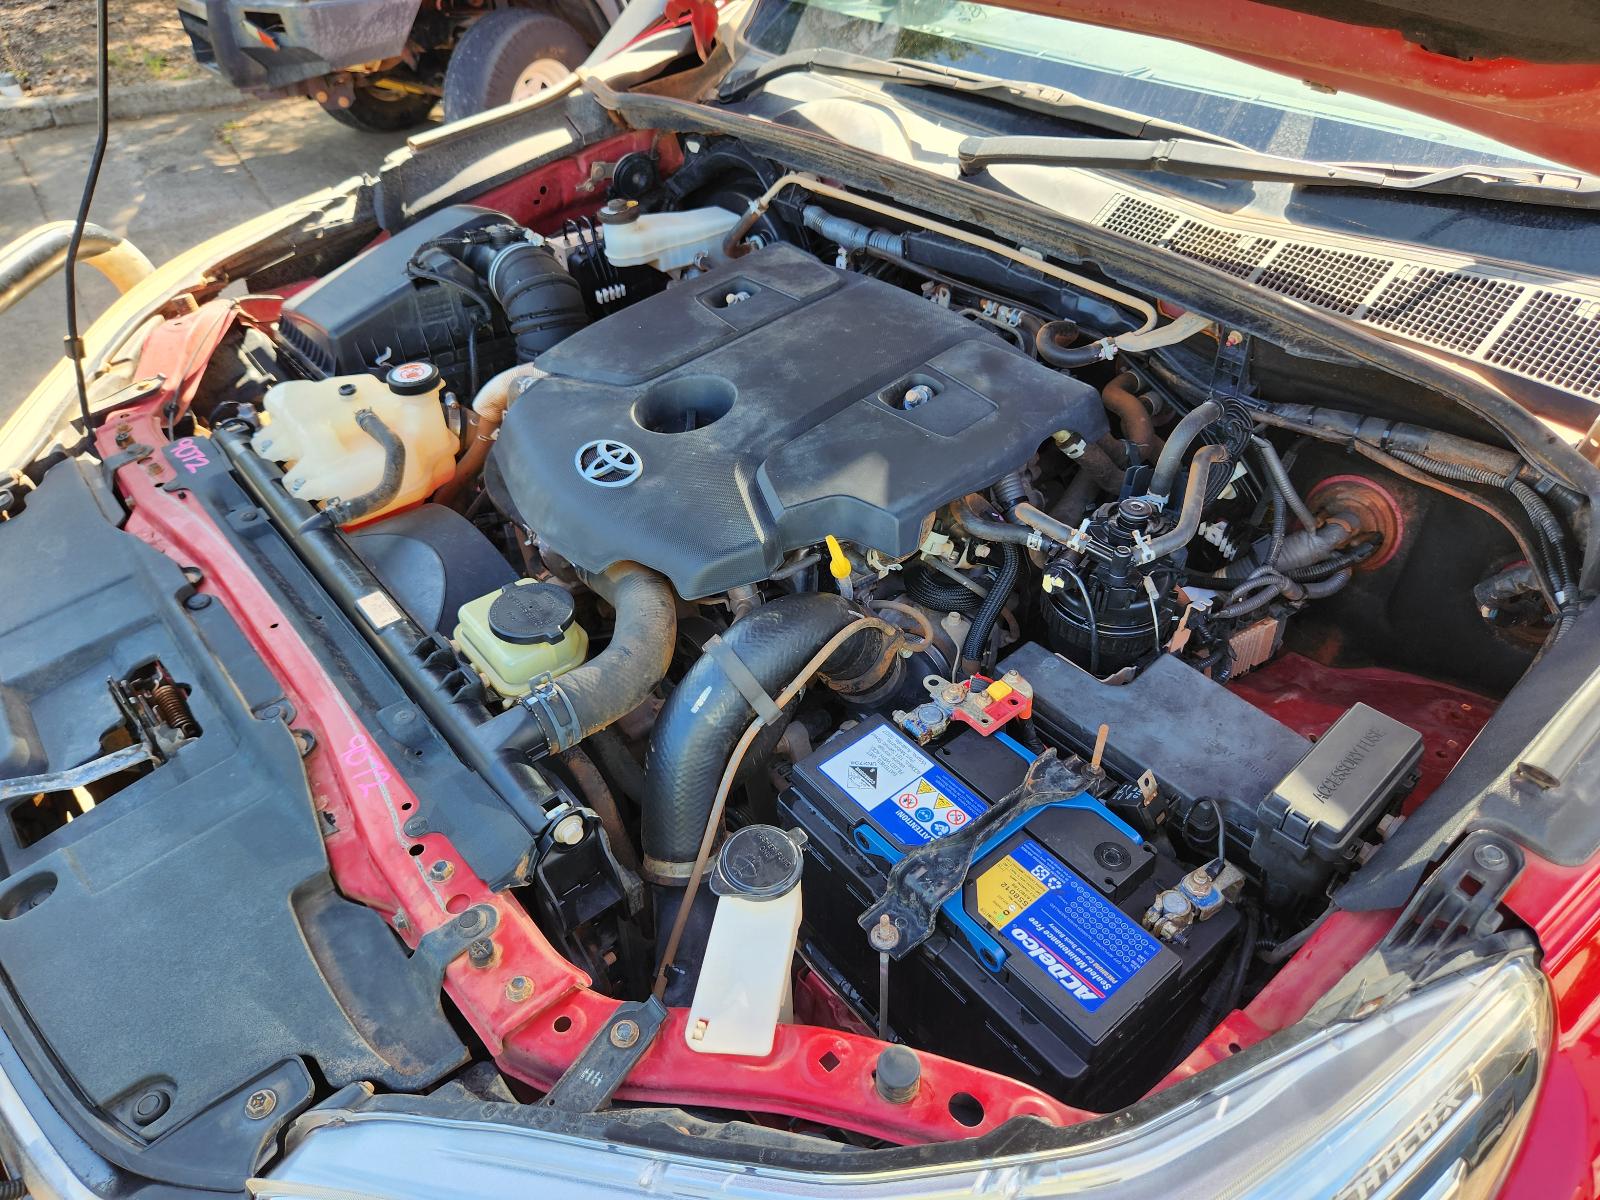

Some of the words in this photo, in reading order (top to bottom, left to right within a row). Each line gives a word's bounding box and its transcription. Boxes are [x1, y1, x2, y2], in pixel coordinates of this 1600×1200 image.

[343, 734, 391, 799] 9072
[894, 808, 931, 839] ATTENTION!
[1026, 915, 1044, 931] Free
[1046, 920, 1066, 939] Battery
[1042, 928, 1088, 969] Maintenance
[1075, 945, 1087, 957] and
[1084, 952, 1095, 964] Car
[1012, 928, 1098, 1000] ACDelco
[1085, 966, 1113, 990] Sealed
